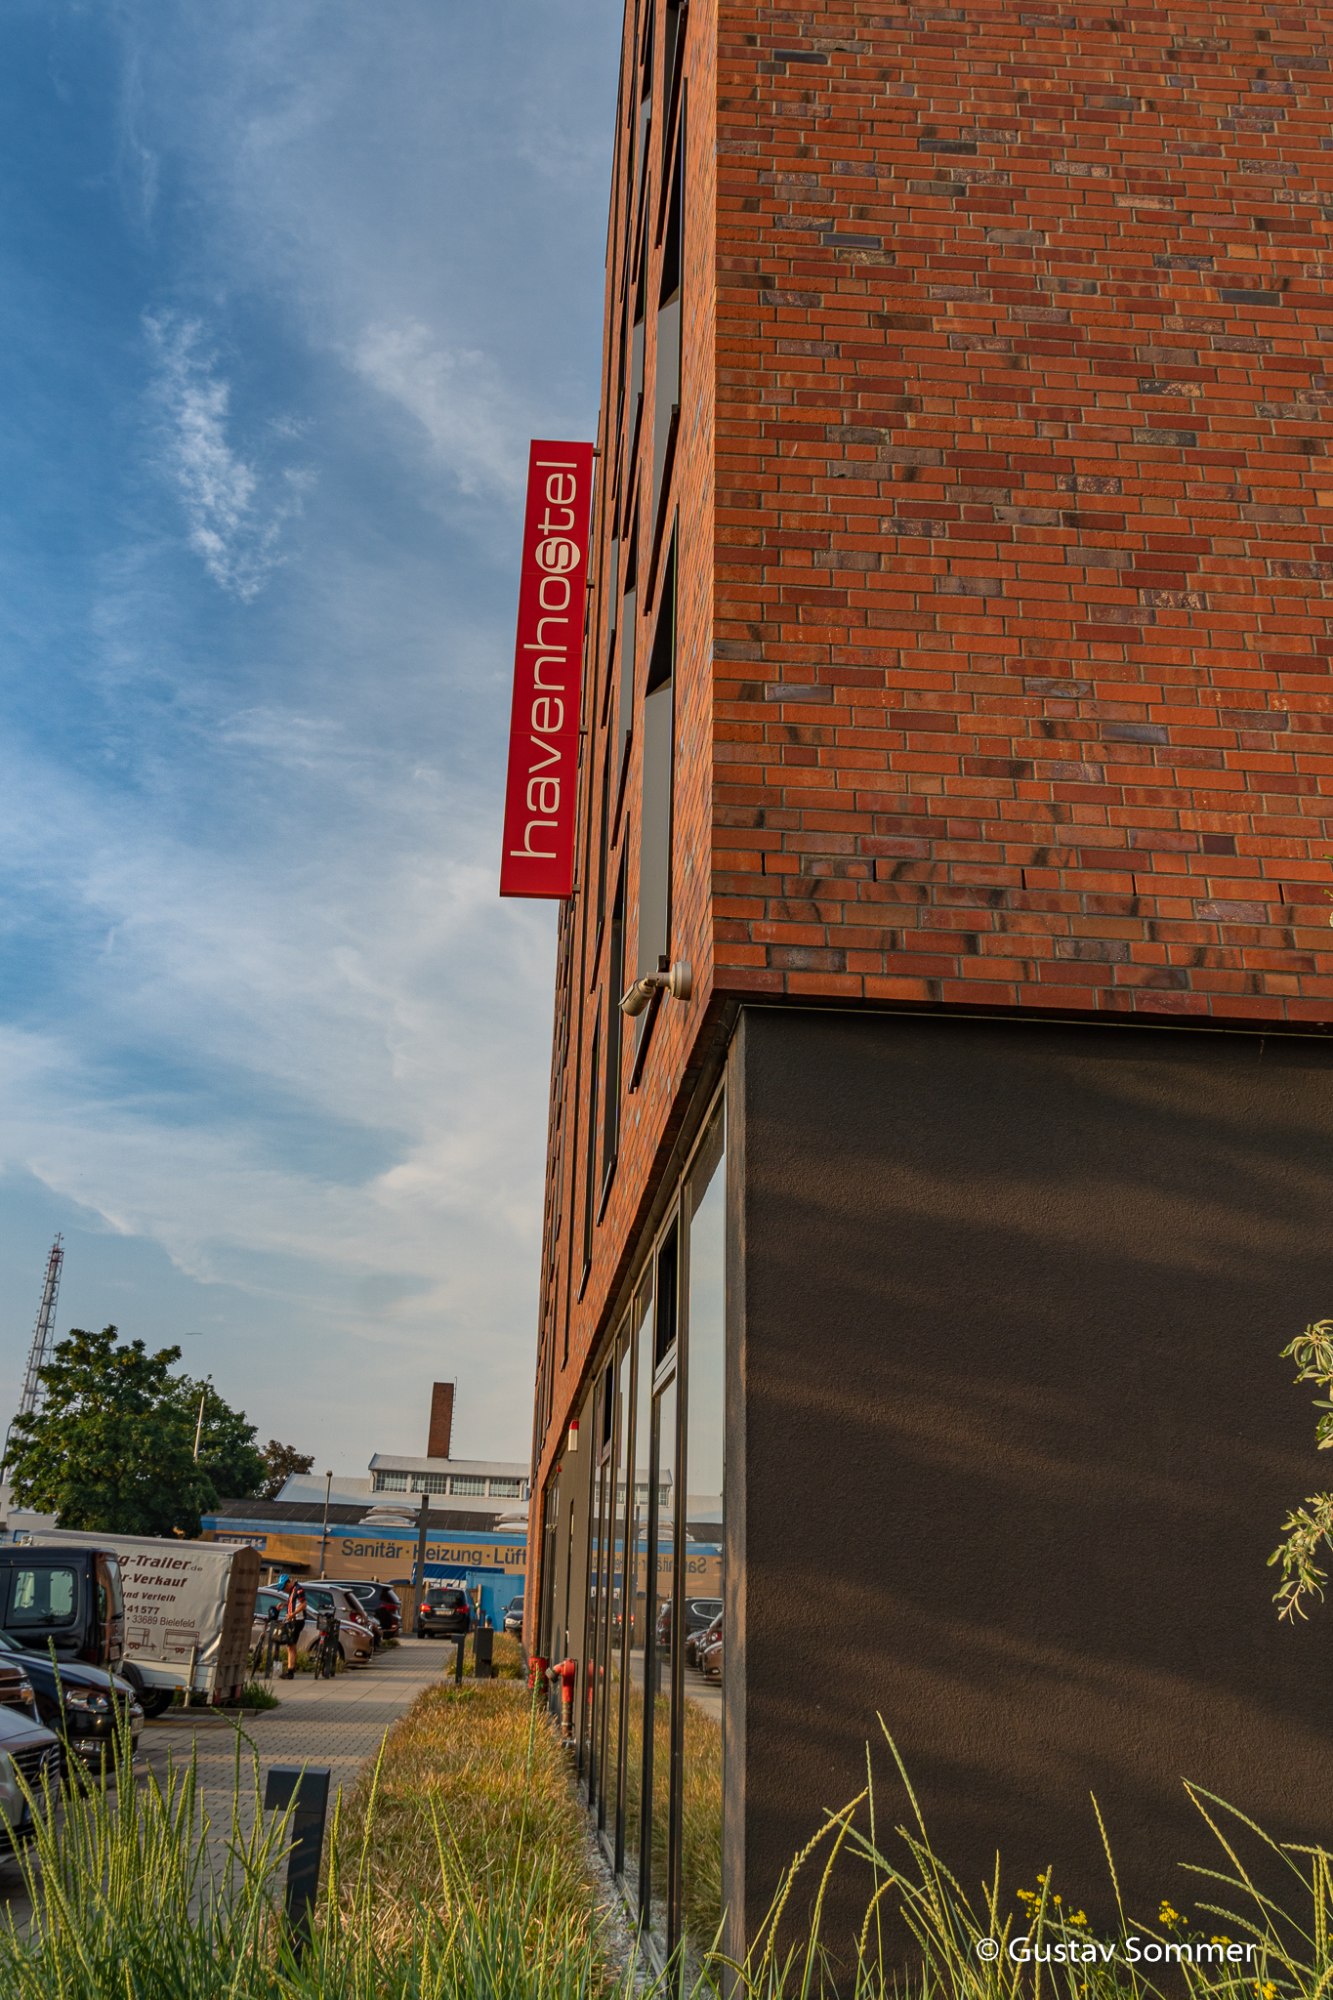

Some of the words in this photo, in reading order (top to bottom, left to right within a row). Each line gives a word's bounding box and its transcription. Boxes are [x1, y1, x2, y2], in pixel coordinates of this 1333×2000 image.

[510, 461, 580, 858] havenhostel
[341, 1538, 403, 1560] Sanitär
[120, 1572, 188, 1588] r-Verkauf
[141, 1592, 176, 1602] Verleih
[131, 1614, 158, 1625] 33689
[160, 1616, 196, 1628] Bielefeld
